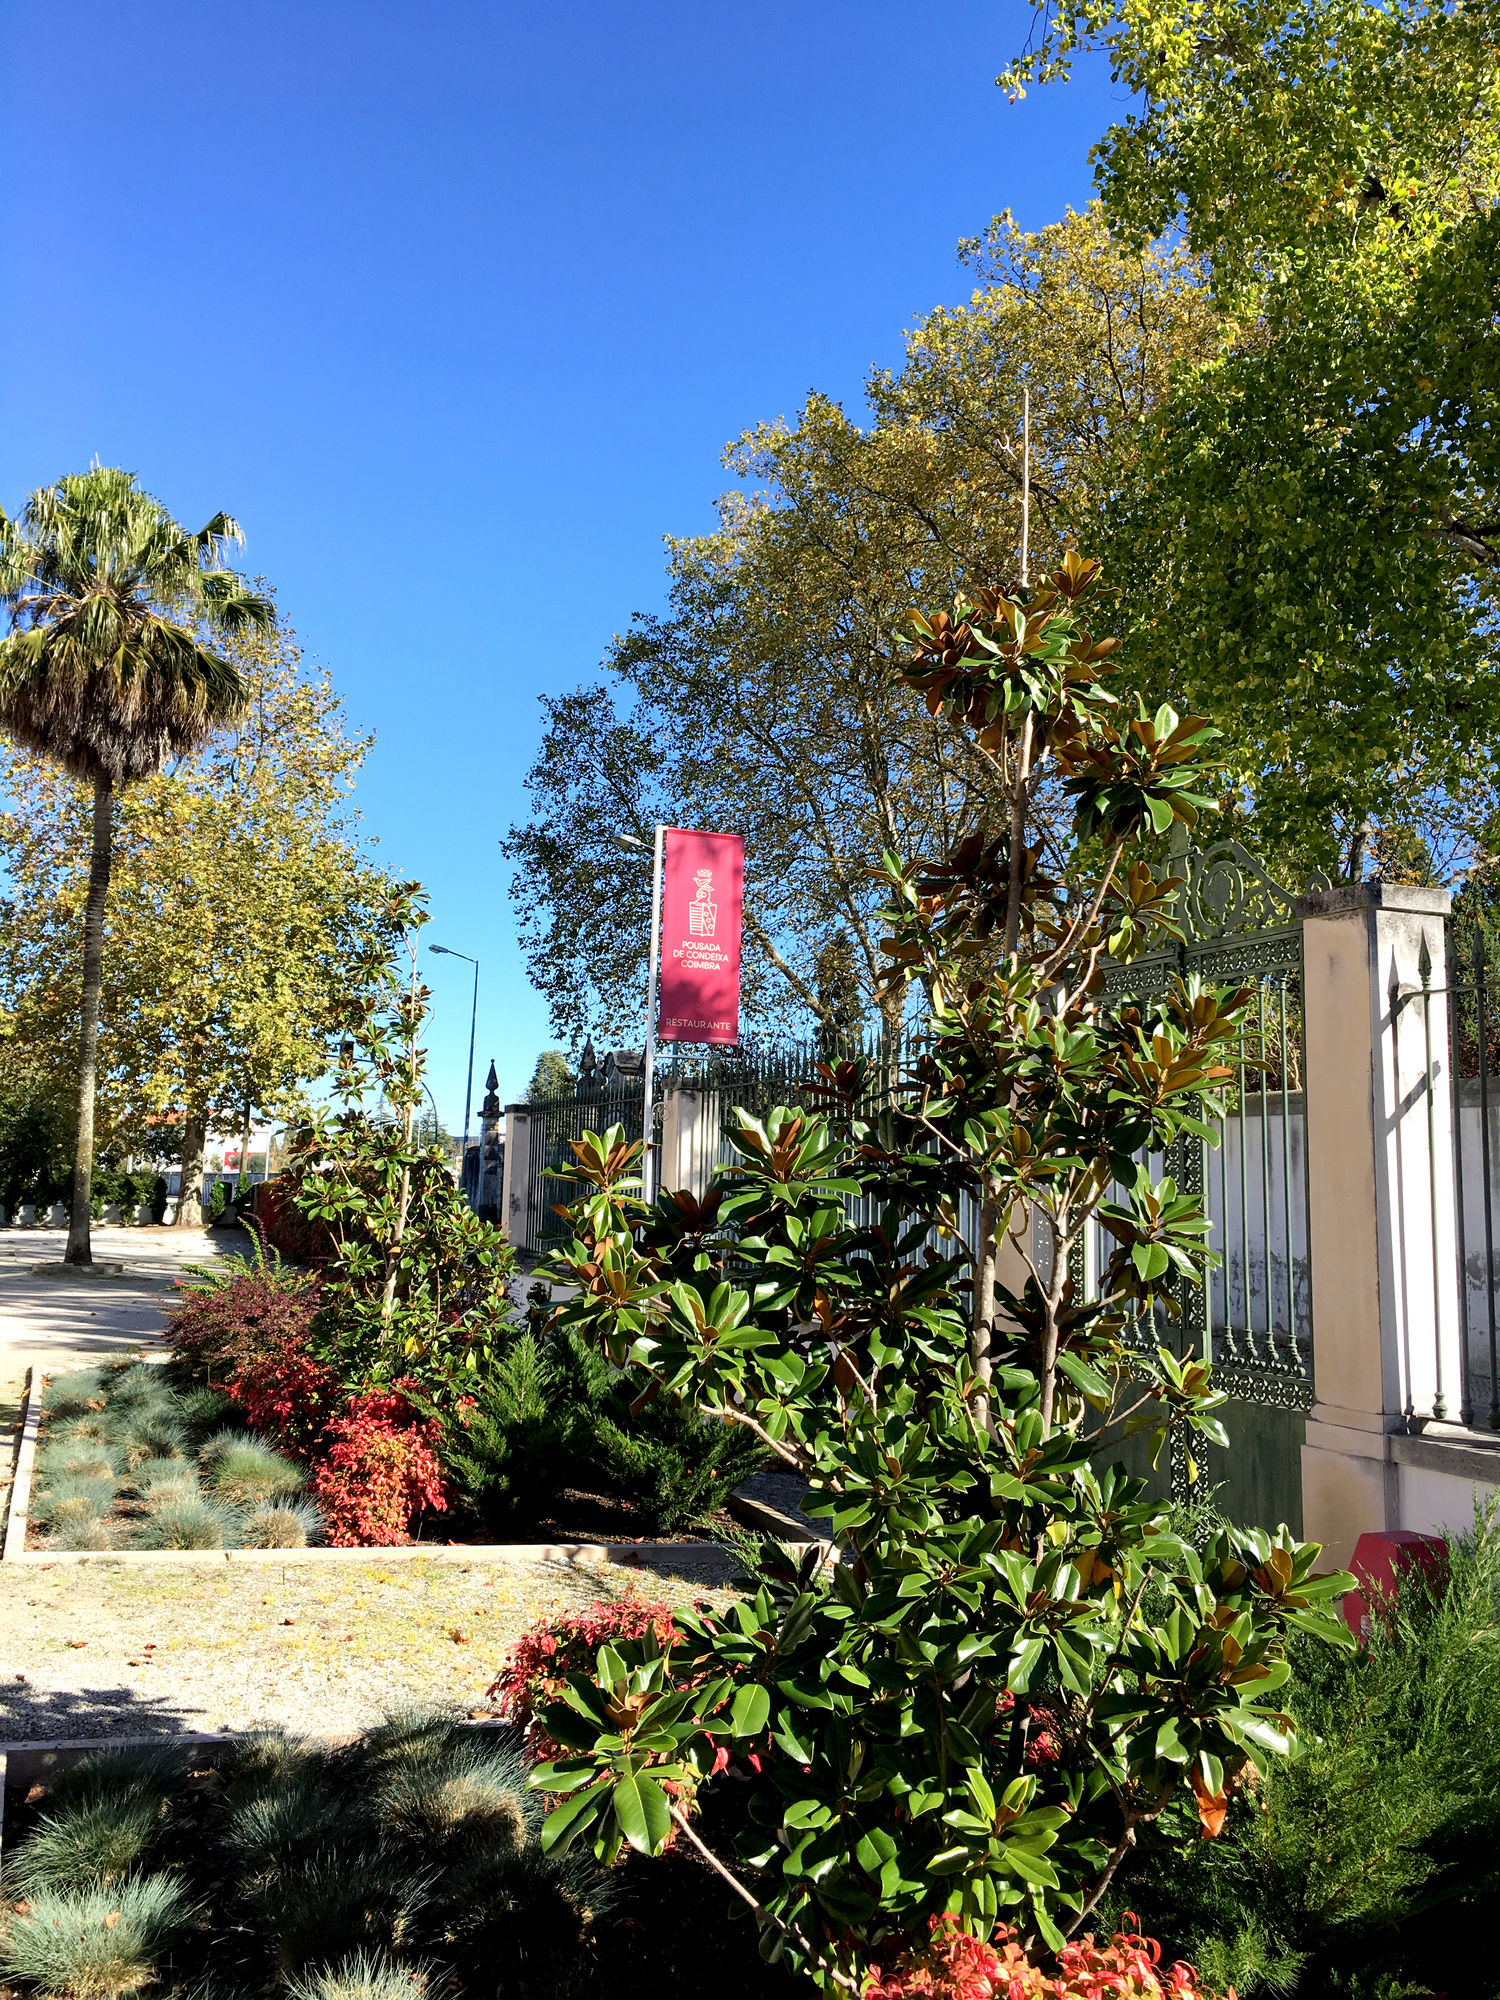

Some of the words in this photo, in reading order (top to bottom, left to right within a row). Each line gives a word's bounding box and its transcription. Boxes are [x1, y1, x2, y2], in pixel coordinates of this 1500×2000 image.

[682, 941, 721, 952] POUSADA
[673, 950, 685, 958] DE
[686, 951, 729, 962] CONDEIXA
[681, 960, 721, 970] COIMBRA
[666, 1018, 731, 1030] RESTAURANTE
